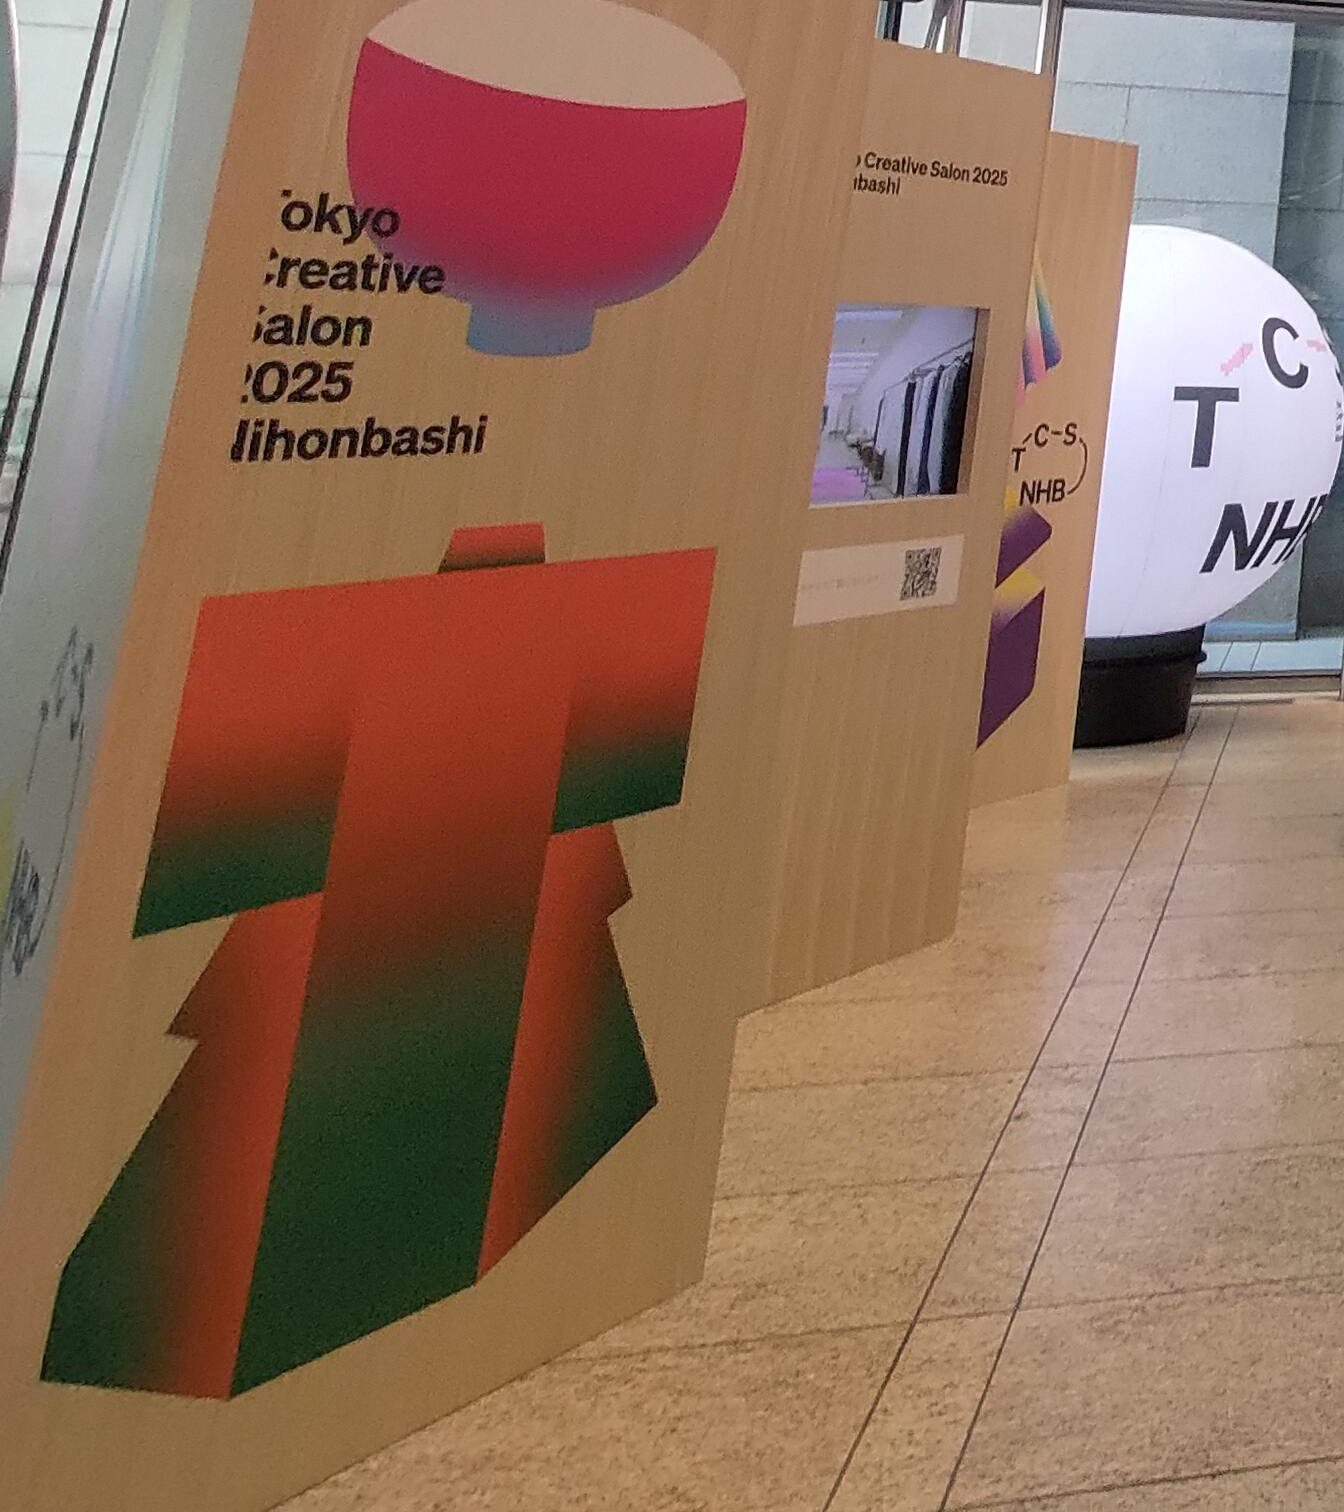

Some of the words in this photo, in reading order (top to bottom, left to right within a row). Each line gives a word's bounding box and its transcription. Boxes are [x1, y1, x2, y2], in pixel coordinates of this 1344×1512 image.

[864, 152, 928, 176] Creative
[930, 161, 970, 183] Salon
[972, 167, 1008, 187] 2025
[280, 189, 400, 245] okyo
[1173, 385, 1240, 469] T
[1019, 478, 1066, 507] NHB
